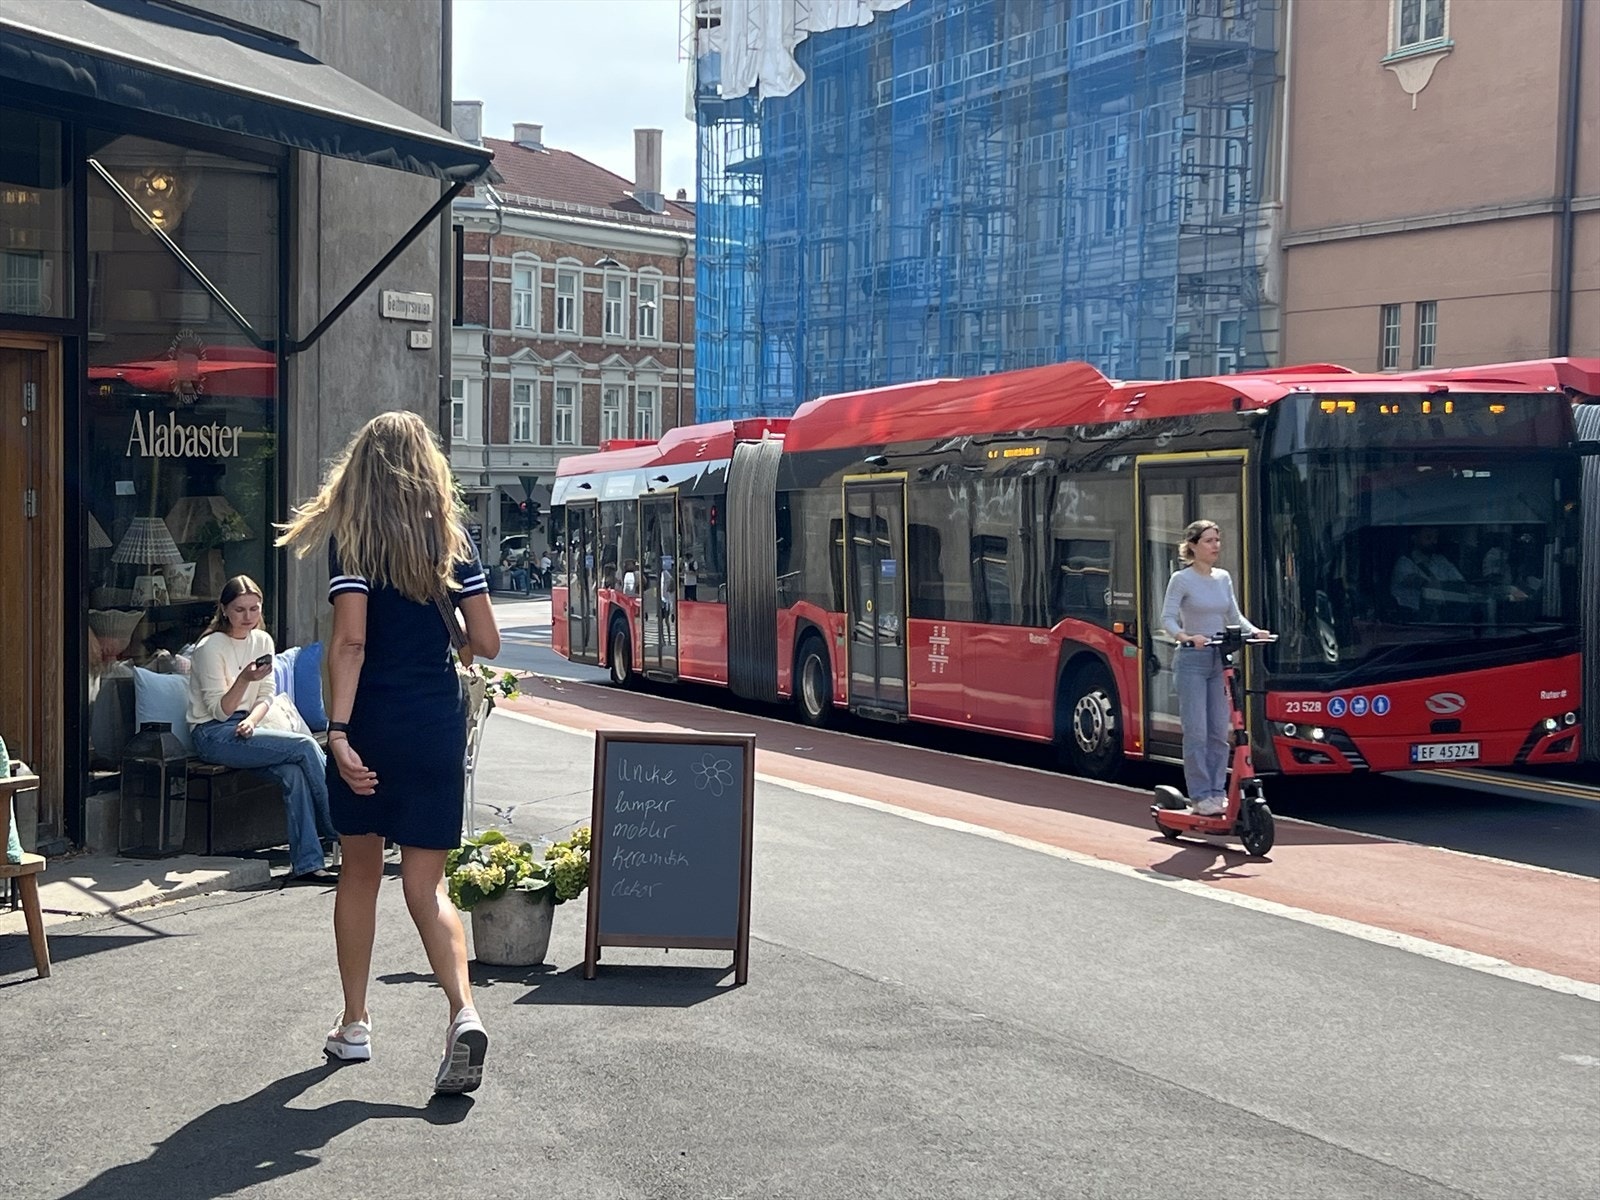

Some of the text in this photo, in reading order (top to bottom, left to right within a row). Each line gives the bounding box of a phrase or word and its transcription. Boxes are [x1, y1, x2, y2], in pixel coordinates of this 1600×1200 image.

[126, 409, 243, 457] Alabaster
[1286, 701, 1321, 713] 23 528
[1422, 745, 1475, 759] EF 45274
[618, 758, 677, 785] Unike
[614, 790, 676, 819] lamper
